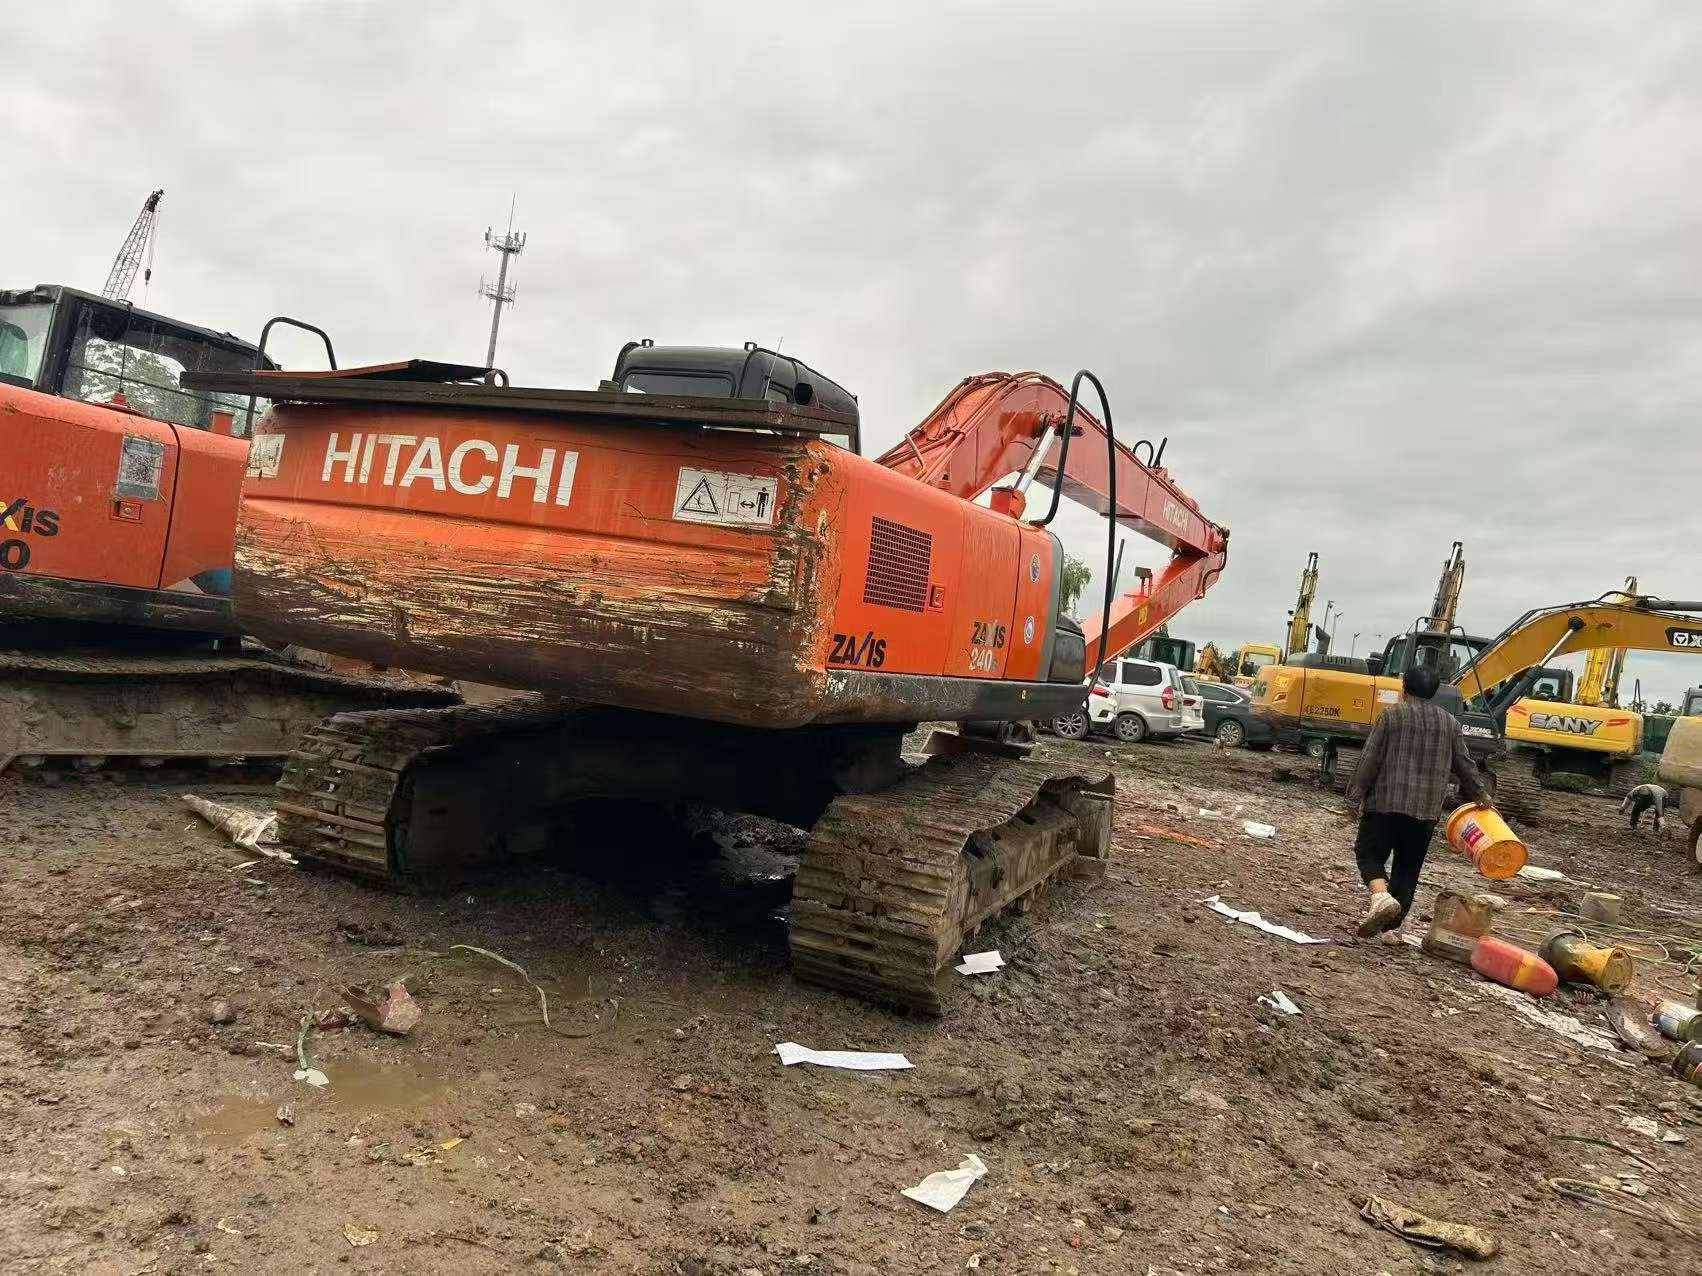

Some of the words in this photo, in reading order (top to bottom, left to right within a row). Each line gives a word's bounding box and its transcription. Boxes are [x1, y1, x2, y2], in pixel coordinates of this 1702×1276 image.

[321, 432, 579, 507] HITACHI
[969, 647, 995, 671] 240
[1529, 713, 1603, 735] SANY
